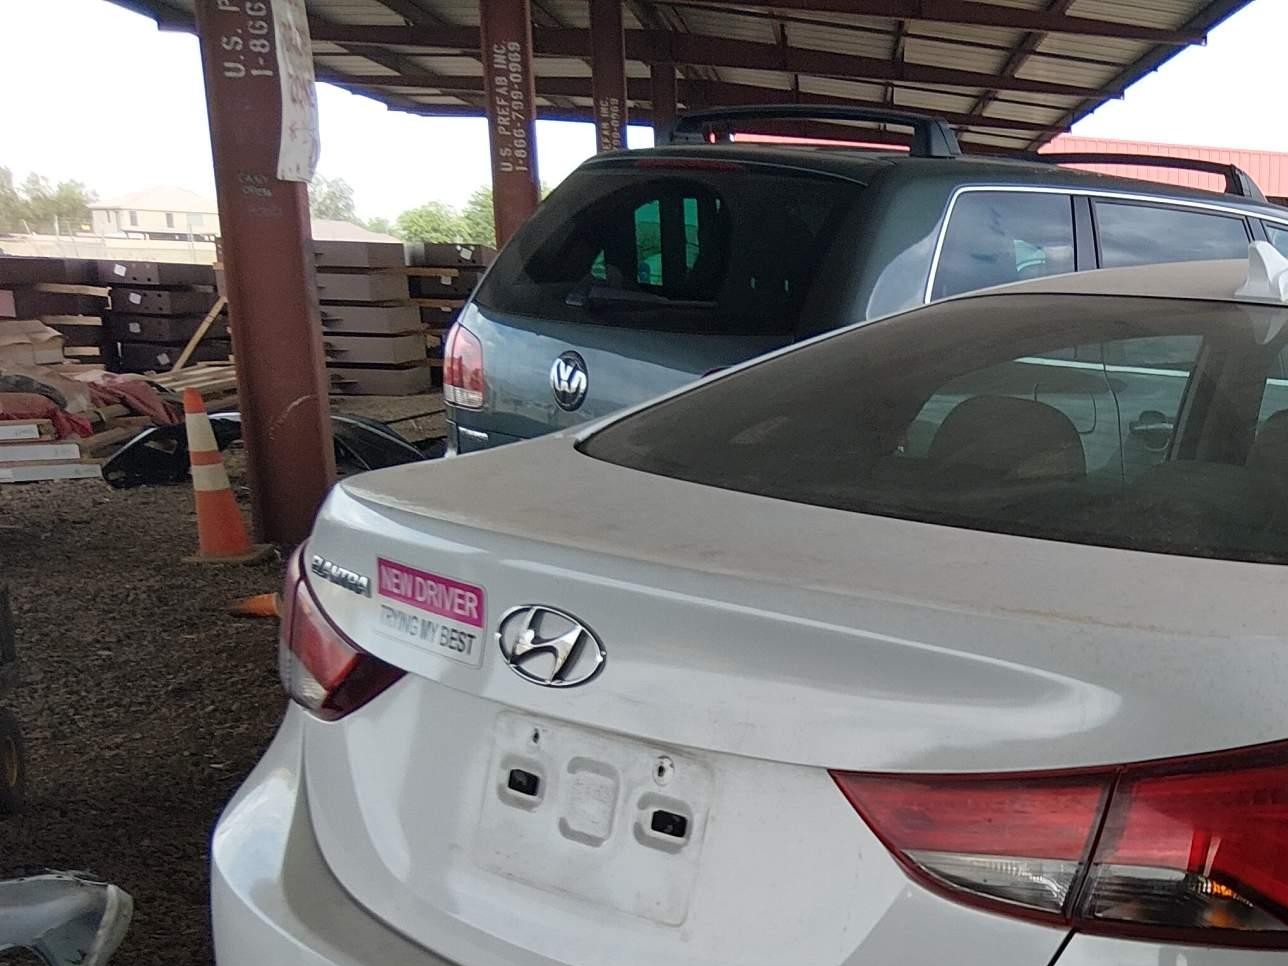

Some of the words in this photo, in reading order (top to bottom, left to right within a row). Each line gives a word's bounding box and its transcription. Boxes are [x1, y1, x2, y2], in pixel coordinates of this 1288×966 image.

[221, 28, 246, 79] U.S.
[492, 40, 507, 69] INC.
[494, 75, 512, 136] PREFAB
[507, 41, 529, 172] 1-866-799-0969
[499, 143, 513, 172] U.S.
[380, 565, 414, 599] NEW
[415, 575, 479, 620] DRIVER
[380, 603, 419, 637] TRYING
[420, 620, 440, 642] MY
[439, 625, 477, 655] BEST
